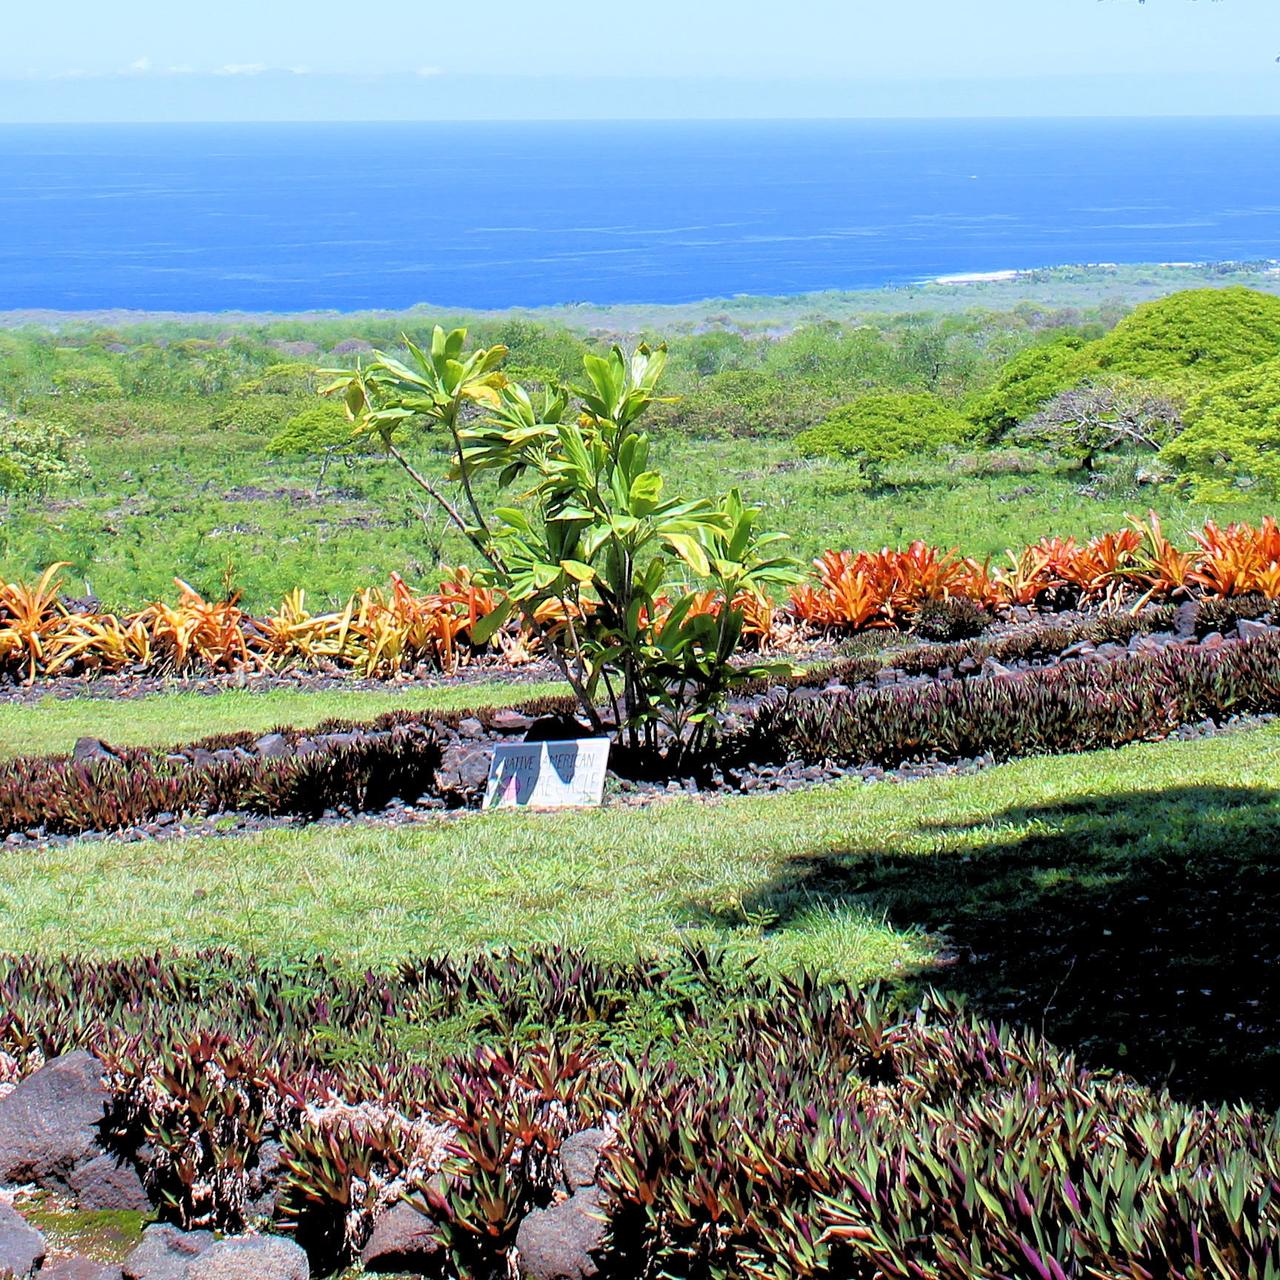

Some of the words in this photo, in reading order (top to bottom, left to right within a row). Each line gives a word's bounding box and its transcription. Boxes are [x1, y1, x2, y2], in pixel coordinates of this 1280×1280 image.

[504, 755, 536, 770] NATIVE
[541, 752, 595, 768] AMERICAN
[556, 772, 599, 793] RCLE
